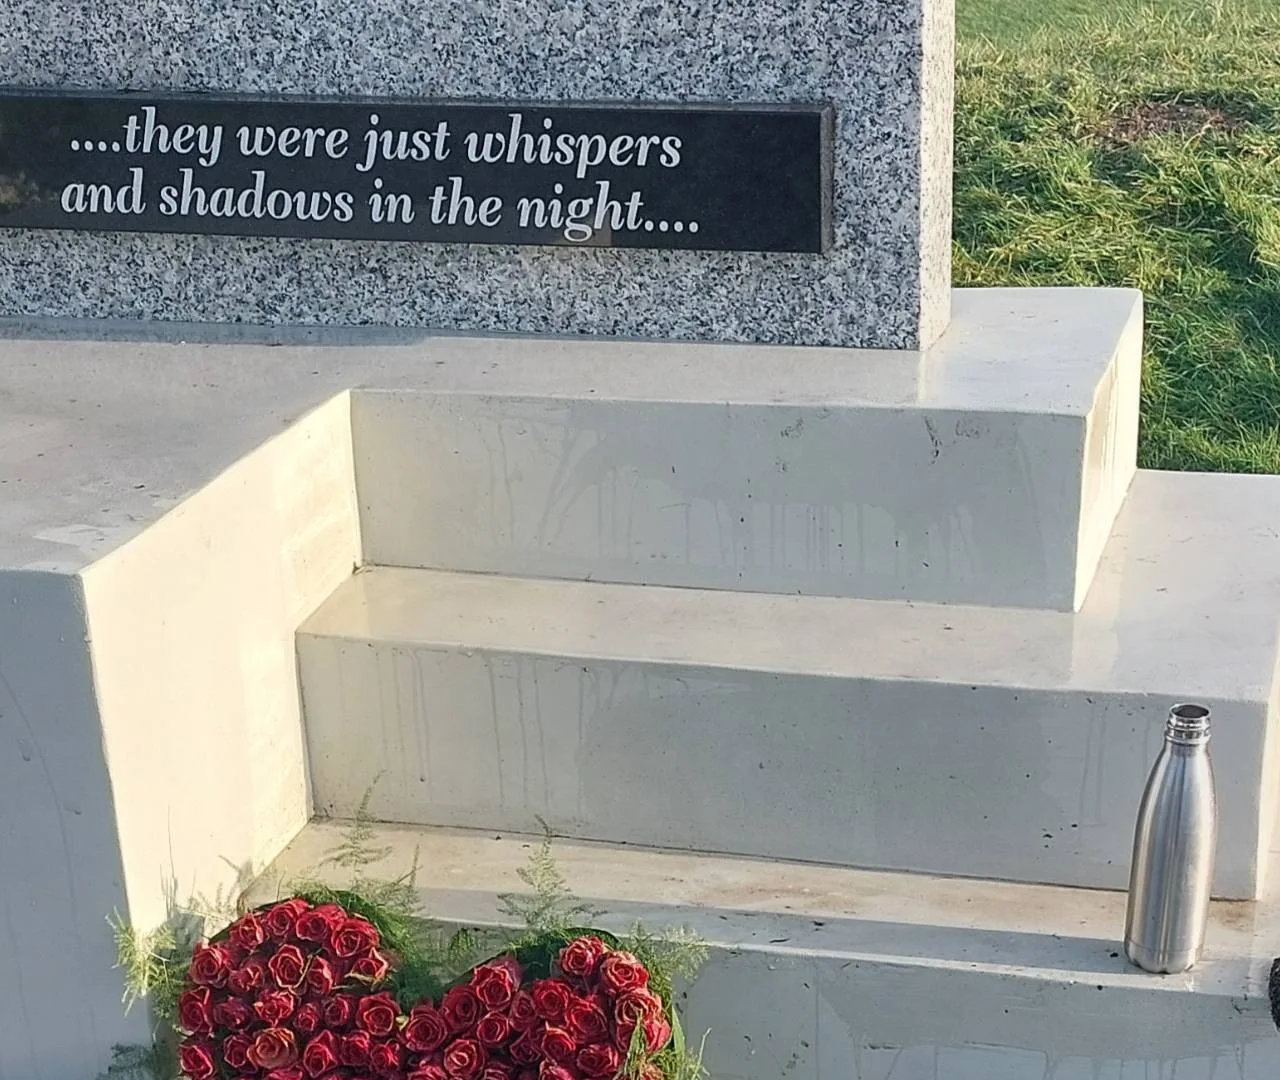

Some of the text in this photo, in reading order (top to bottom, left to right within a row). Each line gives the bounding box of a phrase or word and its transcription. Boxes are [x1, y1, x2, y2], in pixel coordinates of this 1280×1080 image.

[71, 107, 682, 179] ....they were just whispers
[61, 167, 699, 242] and shadows in the night....
